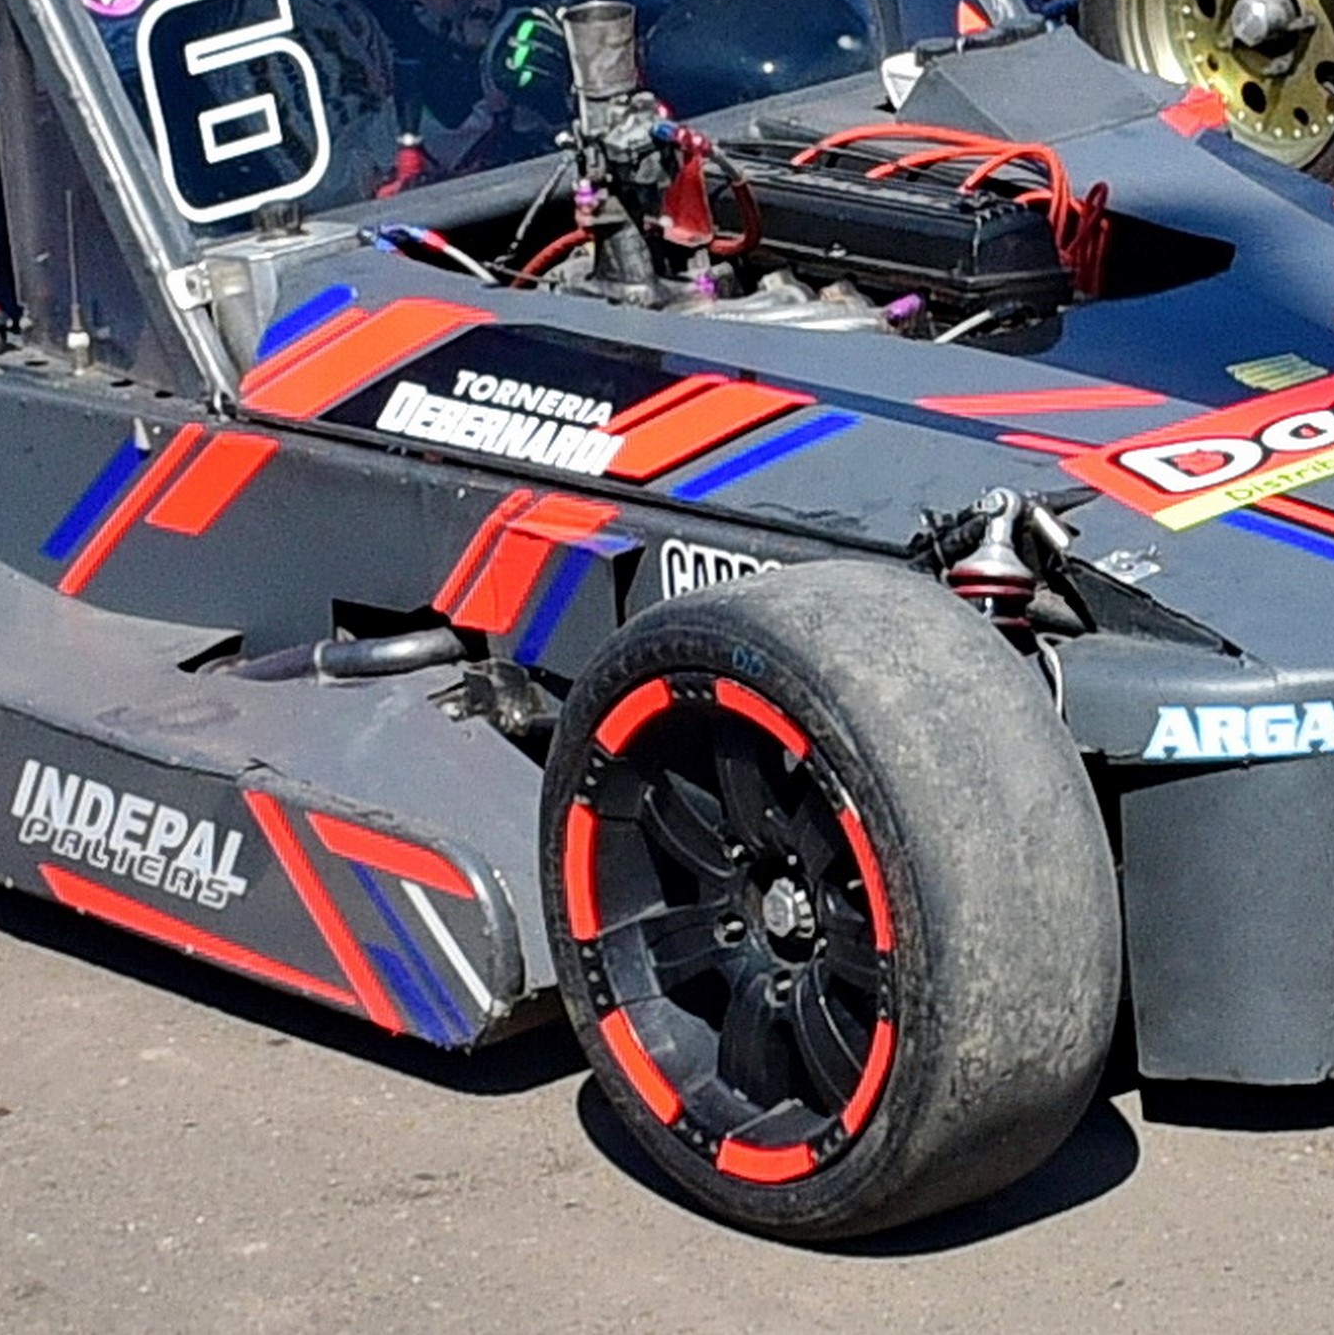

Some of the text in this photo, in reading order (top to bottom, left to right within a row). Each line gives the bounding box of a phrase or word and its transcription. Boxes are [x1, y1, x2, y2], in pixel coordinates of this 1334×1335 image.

[375, 380, 626, 476] DEBERNARDI
[453, 368, 613, 426] TORNERIA
[10, 759, 249, 897] INDEPAL
